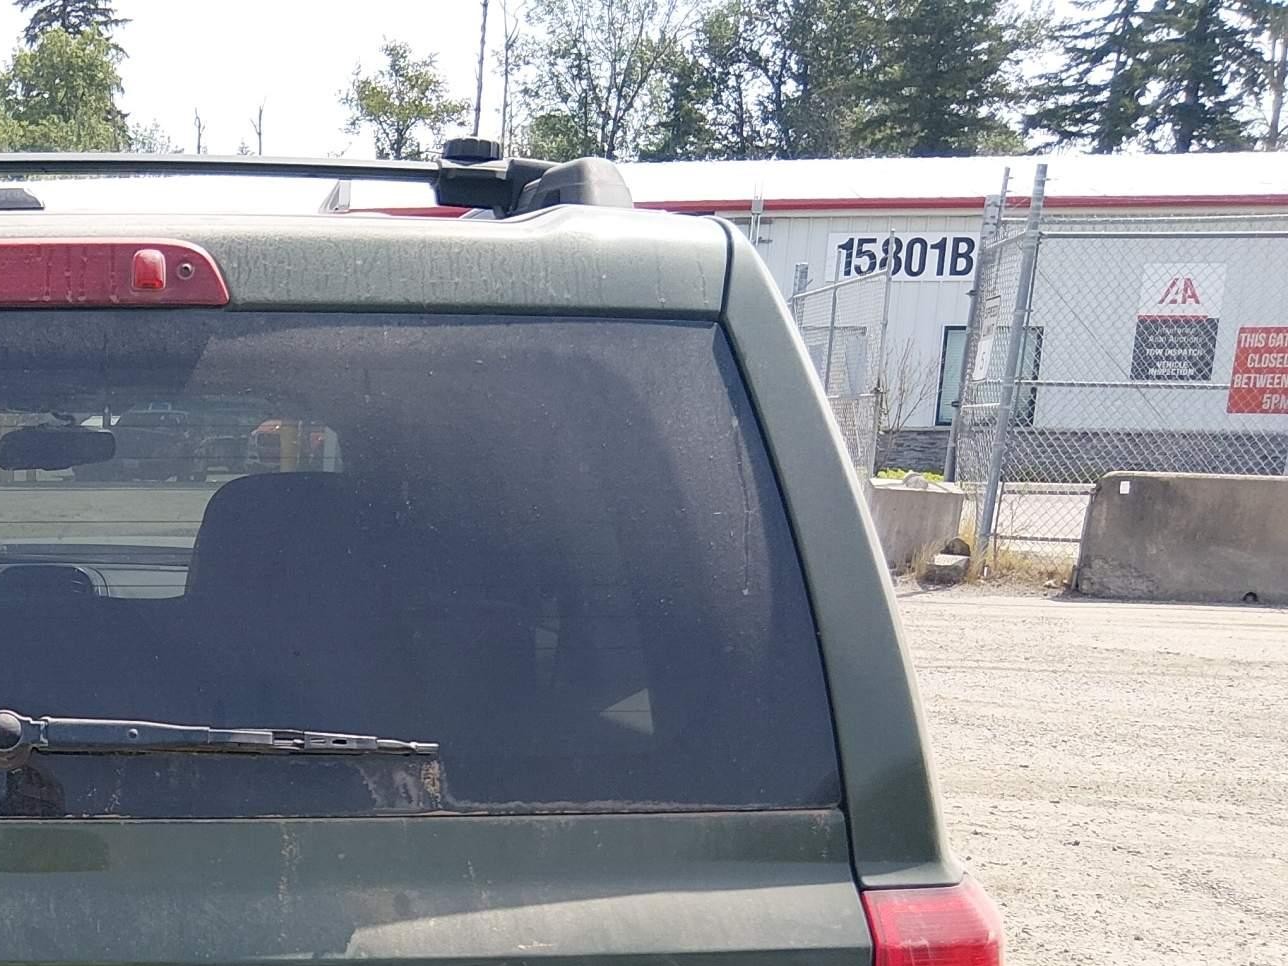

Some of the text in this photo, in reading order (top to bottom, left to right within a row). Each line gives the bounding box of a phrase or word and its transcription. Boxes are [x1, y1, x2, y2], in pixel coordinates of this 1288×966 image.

[837, 237, 976, 277] 15801B
[1240, 333, 1288, 347] THIS GAT
[1234, 373, 1288, 388] BETWEEN
